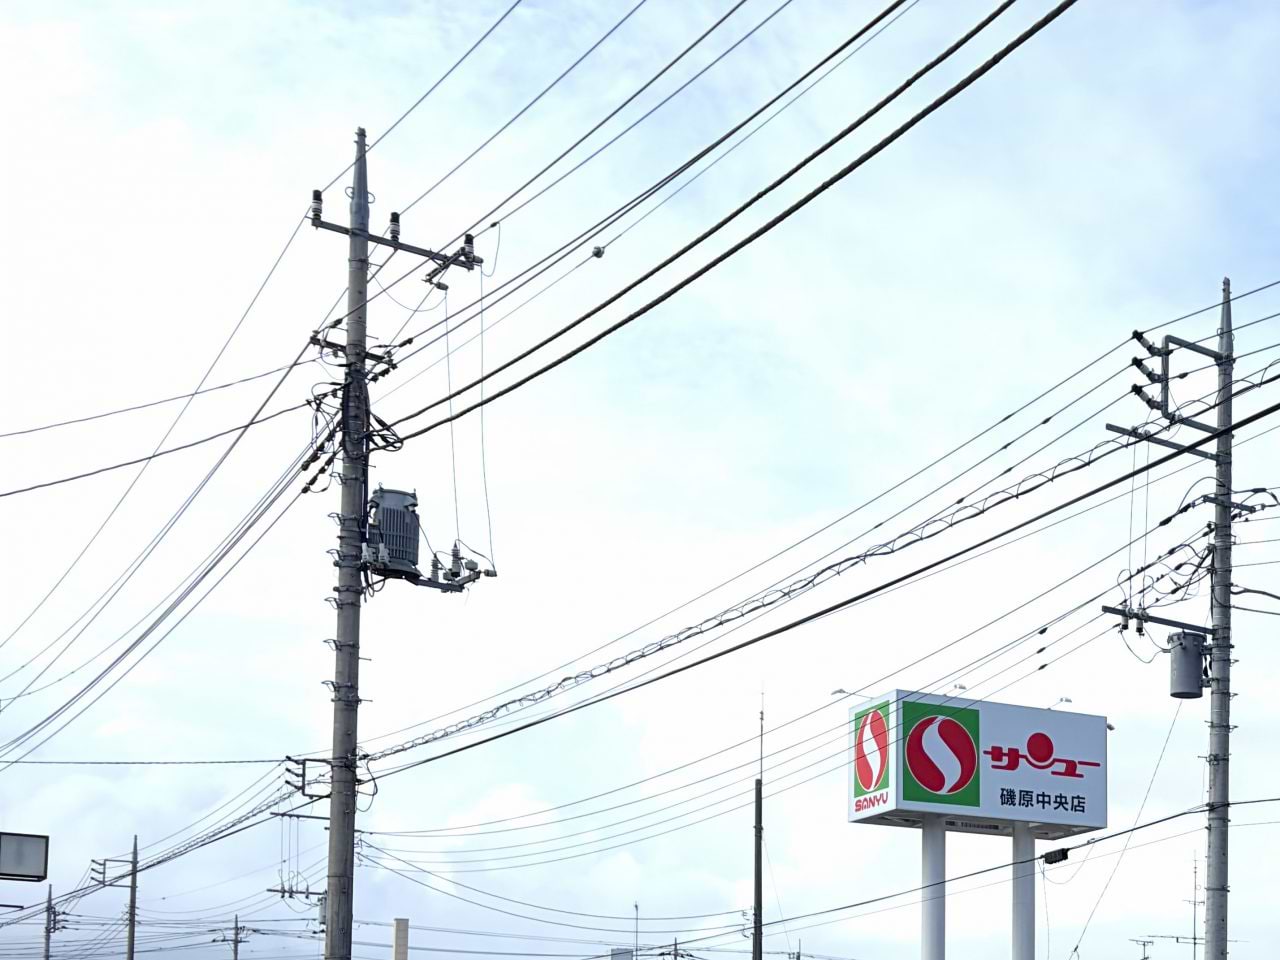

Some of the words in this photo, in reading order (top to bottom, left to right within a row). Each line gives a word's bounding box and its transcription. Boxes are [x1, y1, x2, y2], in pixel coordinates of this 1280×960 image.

[855, 792, 888, 812] SANYU
[1000, 788, 1086, 813] 磯原中央店
